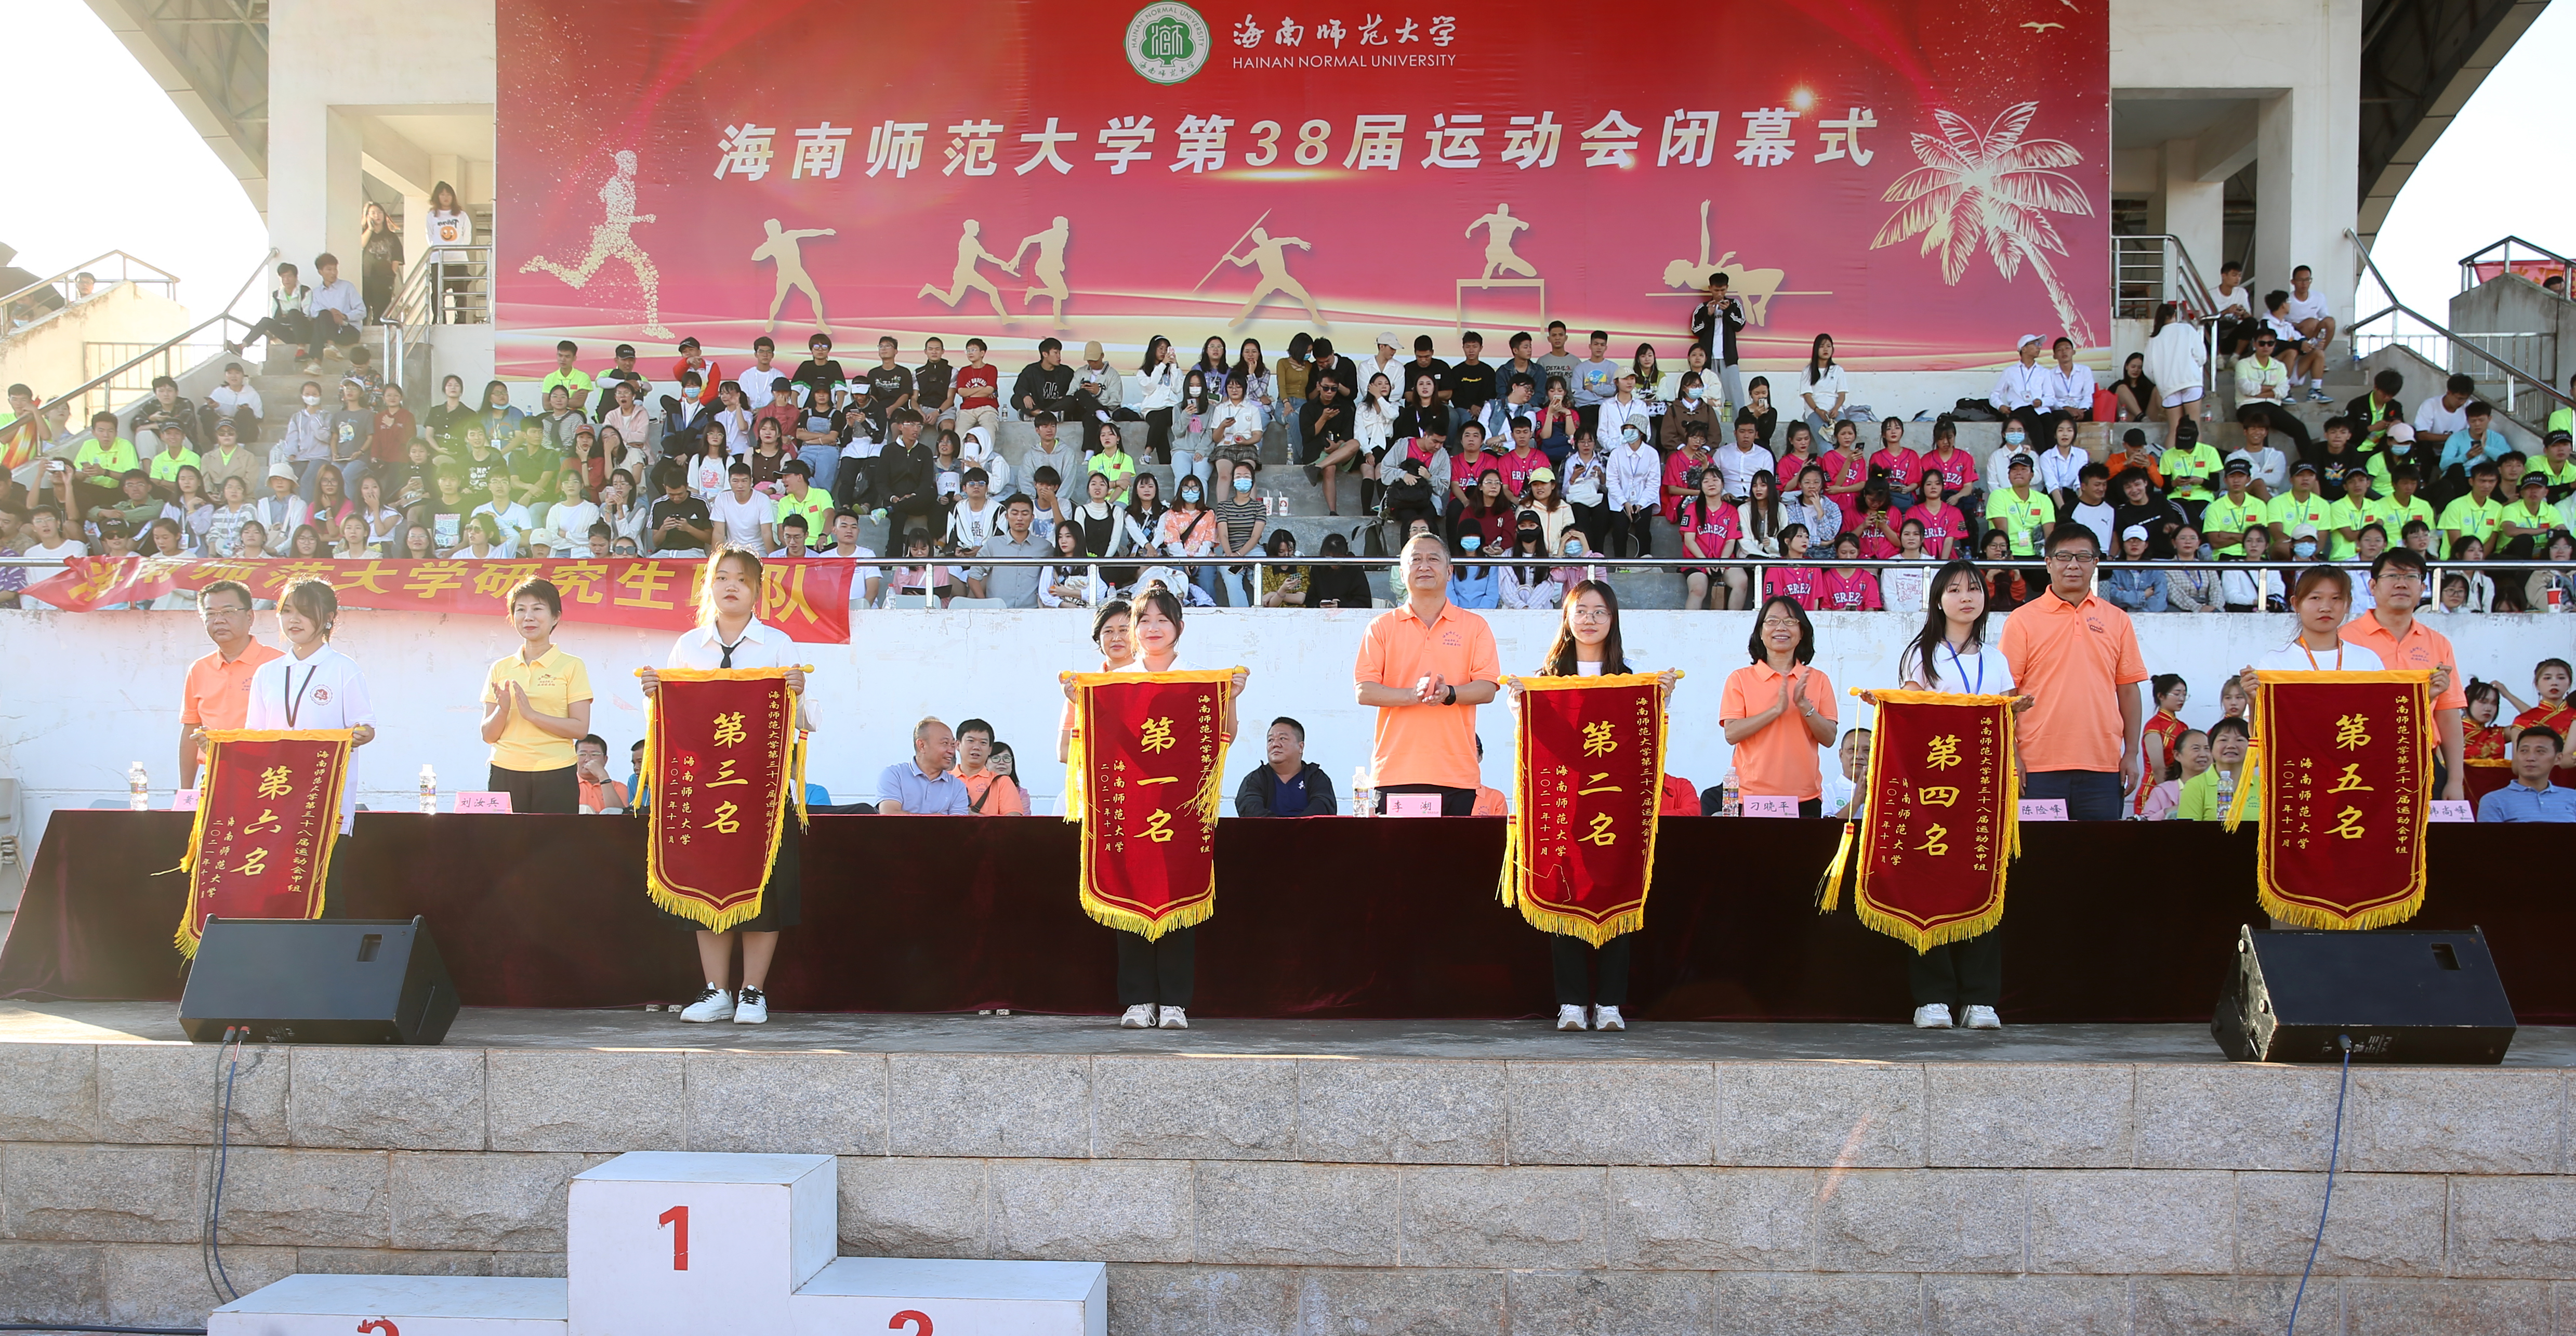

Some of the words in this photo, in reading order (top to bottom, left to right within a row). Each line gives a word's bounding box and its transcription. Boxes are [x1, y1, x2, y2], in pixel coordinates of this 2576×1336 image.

[1132, 19, 1145, 48] HAINAN
[1145, 7, 1178, 19] NORMAL
[1180, 10, 1204, 47] UNIVERSITY
[1233, 14, 1456, 49] 海南师范大学
[1233, 57, 1294, 69] HAINAN
[1299, 56, 1367, 68] NORMAL
[1371, 54, 1456, 67] UNIVERSITY
[713, 108, 1879, 181] 海南师范大学第38届运动会闭幕式
[68, 558, 820, 624] 海南师范大学研究生队
[460, 797, 499, 808] 刘汝兵
[680, 755, 695, 845] 海南师范大学
[702, 711, 748, 834] 第三名
[1113, 759, 1126, 853] 海南师范大学
[1133, 716, 1179, 843] 第一名
[1555, 765, 1569, 857] 海南师范大学
[1577, 720, 1622, 846] 第二名
[1750, 801, 1789, 813] 刁晓平
[1913, 734, 1962, 856] 第四名
[1973, 717, 1994, 871] 海南师范大学第三十八届运动会甲组
[2022, 804, 2062, 816] 陈险峰
[2297, 757, 2313, 849] 海南师范大学
[2323, 713, 2374, 840] 第五名
[2395, 695, 2412, 854] 海南师范大学第三十八届运动会甲组
[206, 816, 236, 898] 海南师范大学
[229, 765, 294, 876] 第六名
[287, 749, 329, 893] 海南师范大学第三十八届运动会甲组
[1890, 777, 1911, 866] 海南师范大学
[659, 1206, 689, 1270] 1
